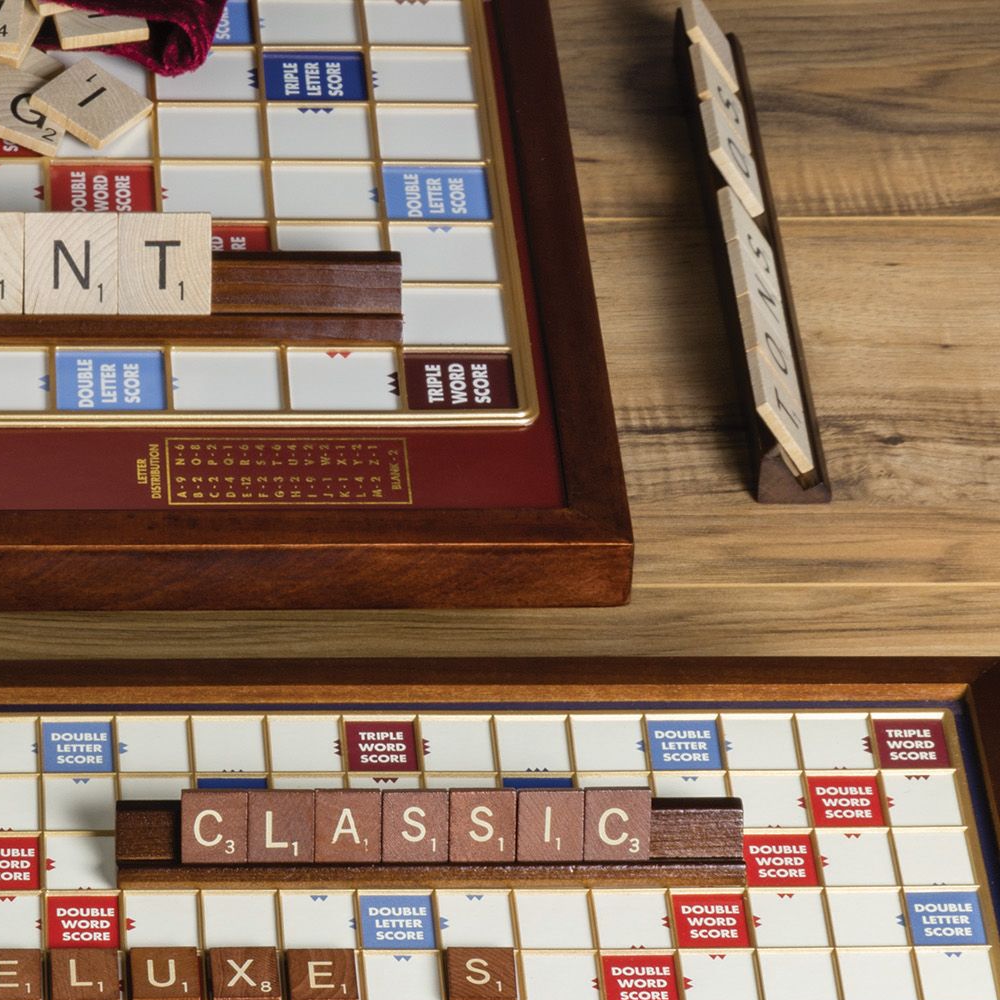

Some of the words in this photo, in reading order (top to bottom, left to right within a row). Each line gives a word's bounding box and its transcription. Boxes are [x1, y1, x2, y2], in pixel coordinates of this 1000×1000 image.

[282, 61, 301, 96] TRIPLE
[304, 60, 322, 96] LETTER
[325, 60, 344, 96] SCORE
[403, 171, 423, 219] DOUBLE
[426, 176, 445, 215] LETTER
[449, 176, 467, 214] SCORE
[76, 358, 95, 408] DOUBLE
[99, 362, 118, 404] LETTER
[122, 362, 142, 404] SCORE
[137, 458, 148, 484] LETTER
[149, 443, 162, 499] DISTRIBUTION
[50, 731, 107, 741] DOUBLE
[885, 728, 931, 738] TRIPLE
[56, 743, 102, 752] LETTER
[885, 739, 935, 749] WORD
[56, 754, 103, 764] SCORE
[889, 750, 937, 760] SCORE
[748, 844, 807, 854] DOUBLE
[754, 856, 804, 866] WORD
[757, 868, 806, 878] SCORE
[55, 907, 114, 917] DOUBLE
[913, 902, 973, 912] DOUBLE
[60, 919, 110, 929] WORD
[921, 914, 970, 924] LETTER
[62, 931, 110, 941] SCORE
[923, 926, 973, 936] SCORE
[610, 966, 670, 976] DOUBLE
[616, 978, 667, 988] WORD
[619, 990, 669, 1000] SCORE
